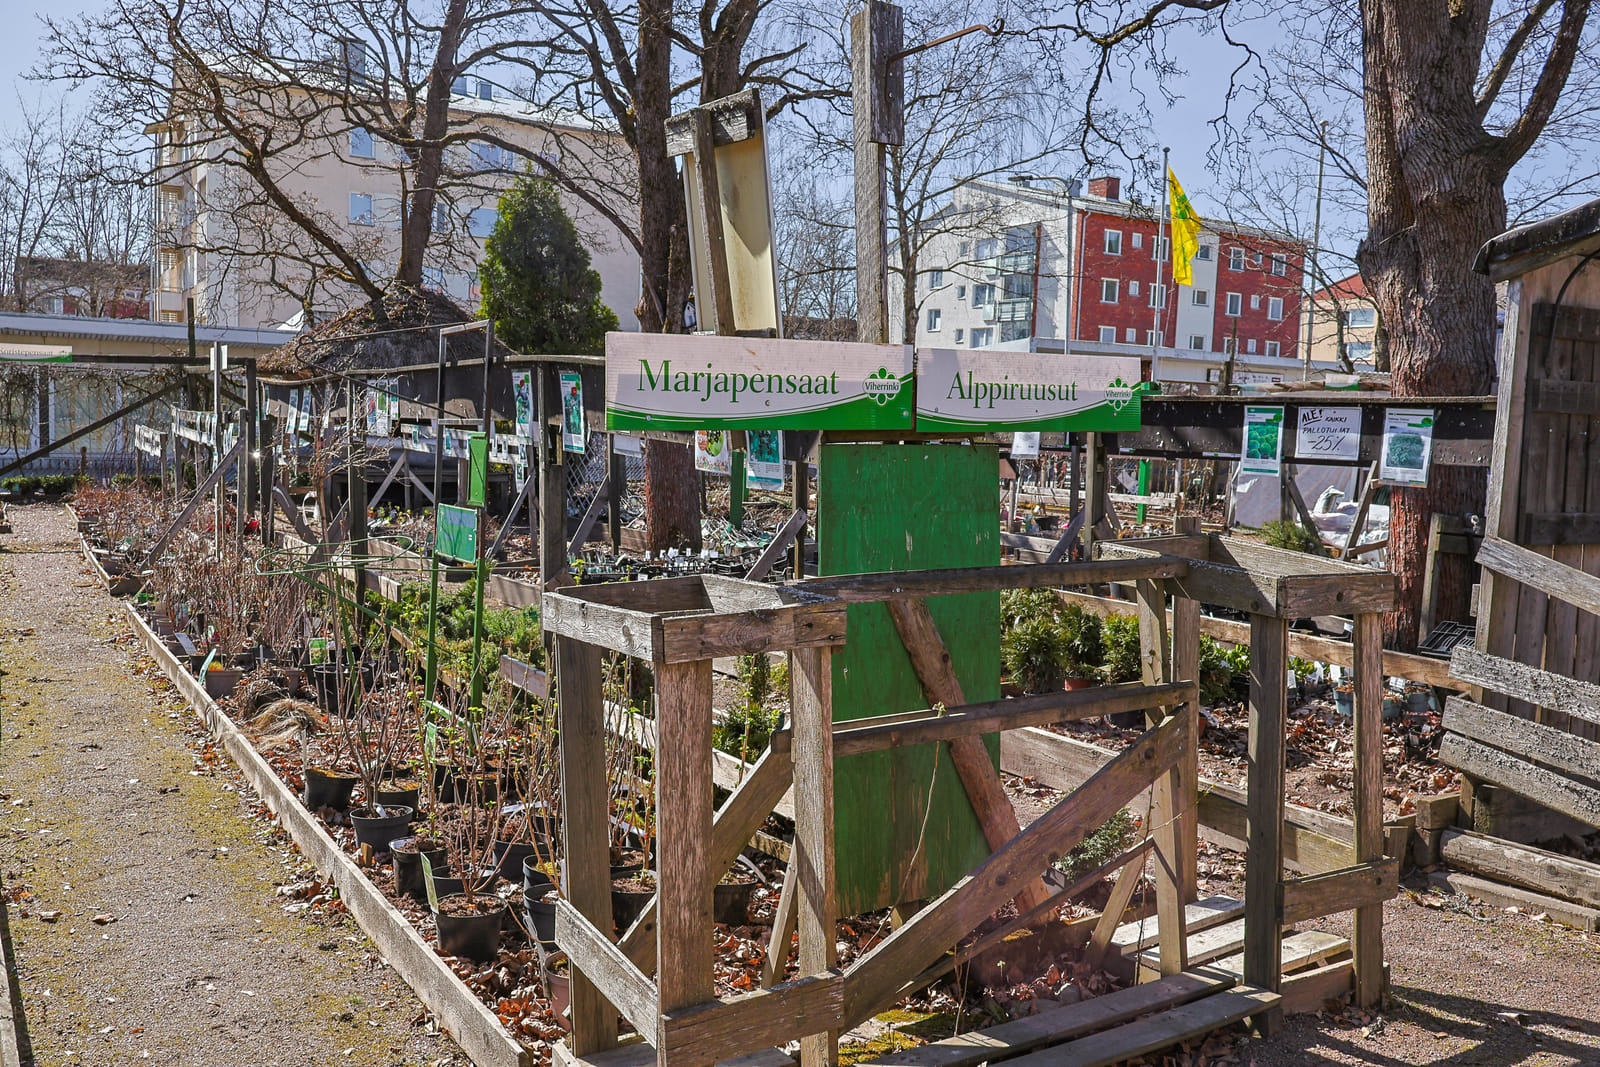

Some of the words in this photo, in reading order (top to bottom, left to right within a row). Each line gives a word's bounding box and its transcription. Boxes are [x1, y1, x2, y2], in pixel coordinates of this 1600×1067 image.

[638, 359, 840, 404] Marjapensaat
[864, 381, 900, 392] Viherrinki
[947, 370, 1079, 409] Alppiruusut
[1302, 408, 1323, 423] ALE!
[1308, 435, 1346, 451] -25%
